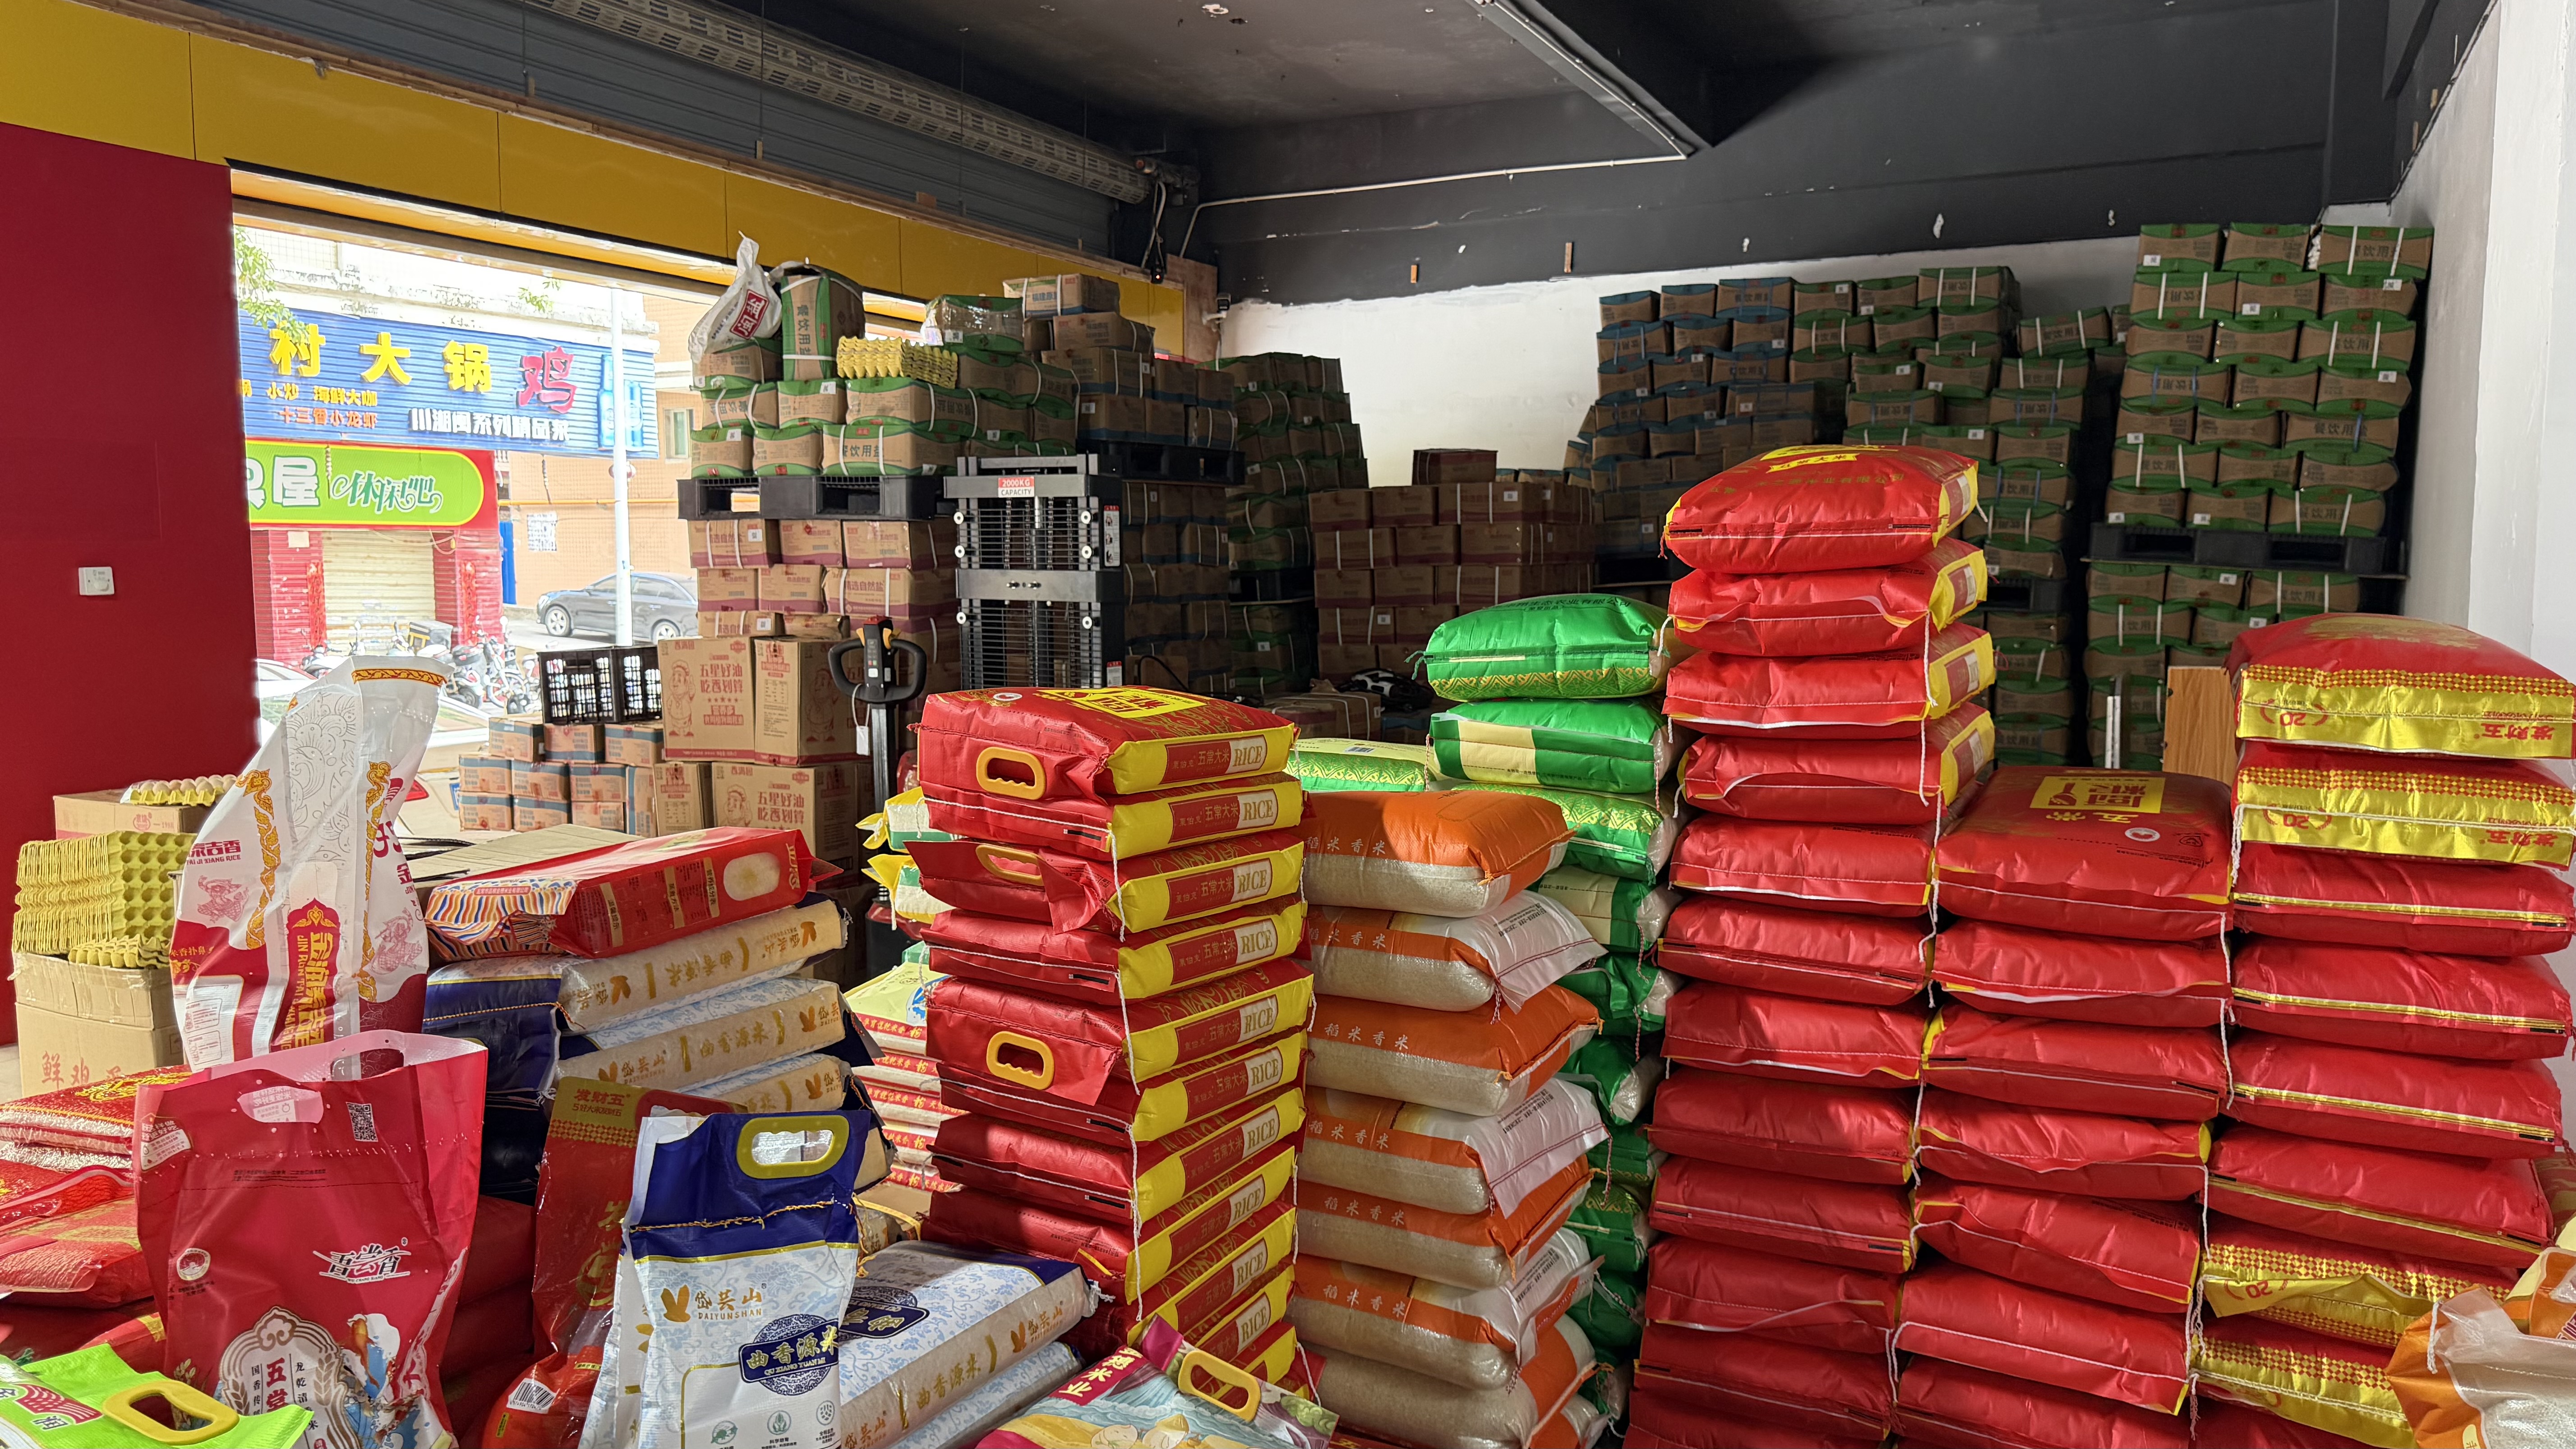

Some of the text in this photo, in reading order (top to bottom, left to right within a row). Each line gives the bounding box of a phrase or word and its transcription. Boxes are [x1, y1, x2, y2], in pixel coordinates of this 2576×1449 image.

[270, 323, 577, 414] 村大锅鸡
[267, 382, 299, 400] 小炒
[314, 386, 378, 406] 海鲜大咖
[279, 406, 377, 428] 十三香小龙虾
[409, 408, 570, 441] 川湘闽系列精品菜
[331, 470, 443, 514] 休闲吧
[1002, 479, 1030, 487] 2000KG
[700, 663, 742, 677] 五星好油
[2280, 712, 2305, 726] 20
[2481, 723, 2554, 740] 发财五
[1198, 745, 1229, 764] 五常大米
[1234, 745, 1263, 767] RICE
[757, 791, 804, 807] 五星好油
[1205, 800, 1239, 819] 五常大米
[1242, 799, 1273, 821] RICE
[2283, 814, 2309, 829] 20
[1307, 837, 1385, 855] 稻米香米
[2487, 830, 2558, 846] 发财五
[1201, 876, 1233, 897] 五常大米
[1237, 869, 1267, 894] RICE
[297, 935, 308, 952] JIN
[1203, 938, 1236, 959] 五常大米
[1241, 930, 1273, 955] RICE
[1311, 928, 1385, 949] 稻米香米
[665, 950, 734, 987] 曲香源米
[1209, 1019, 1240, 1041] 五常大米
[1244, 1007, 1274, 1034] RICE
[700, 1022, 768, 1058] 曲香源米
[1325, 1023, 1408, 1050] 稻米香米
[1217, 1069, 1248, 1094] 五常大米
[1251, 1059, 1279, 1086] RICE
[574, 1088, 626, 1107] 发财五
[1247, 1118, 1275, 1150] RICE
[1309, 1120, 1388, 1150] 稻米香米
[1213, 1135, 1243, 1164] 五常大米
[1233, 1187, 1261, 1221] RICE
[1325, 1196, 1404, 1226] 稻米香米
[1236, 1252, 1263, 1287] RICE
[1324, 1284, 1405, 1318] 稻米香米
[2246, 1281, 2272, 1298] 20
[698, 1308, 762, 1320] DAIYUNSHAN
[1241, 1308, 1267, 1343] RICE
[747, 1326, 838, 1369] 曲香源米
[775, 1364, 796, 1374] XIANG
[798, 1361, 817, 1371] YUAN
[917, 1353, 980, 1409] 曲香源米
[295, 1362, 318, 1430] 龙乾清米
